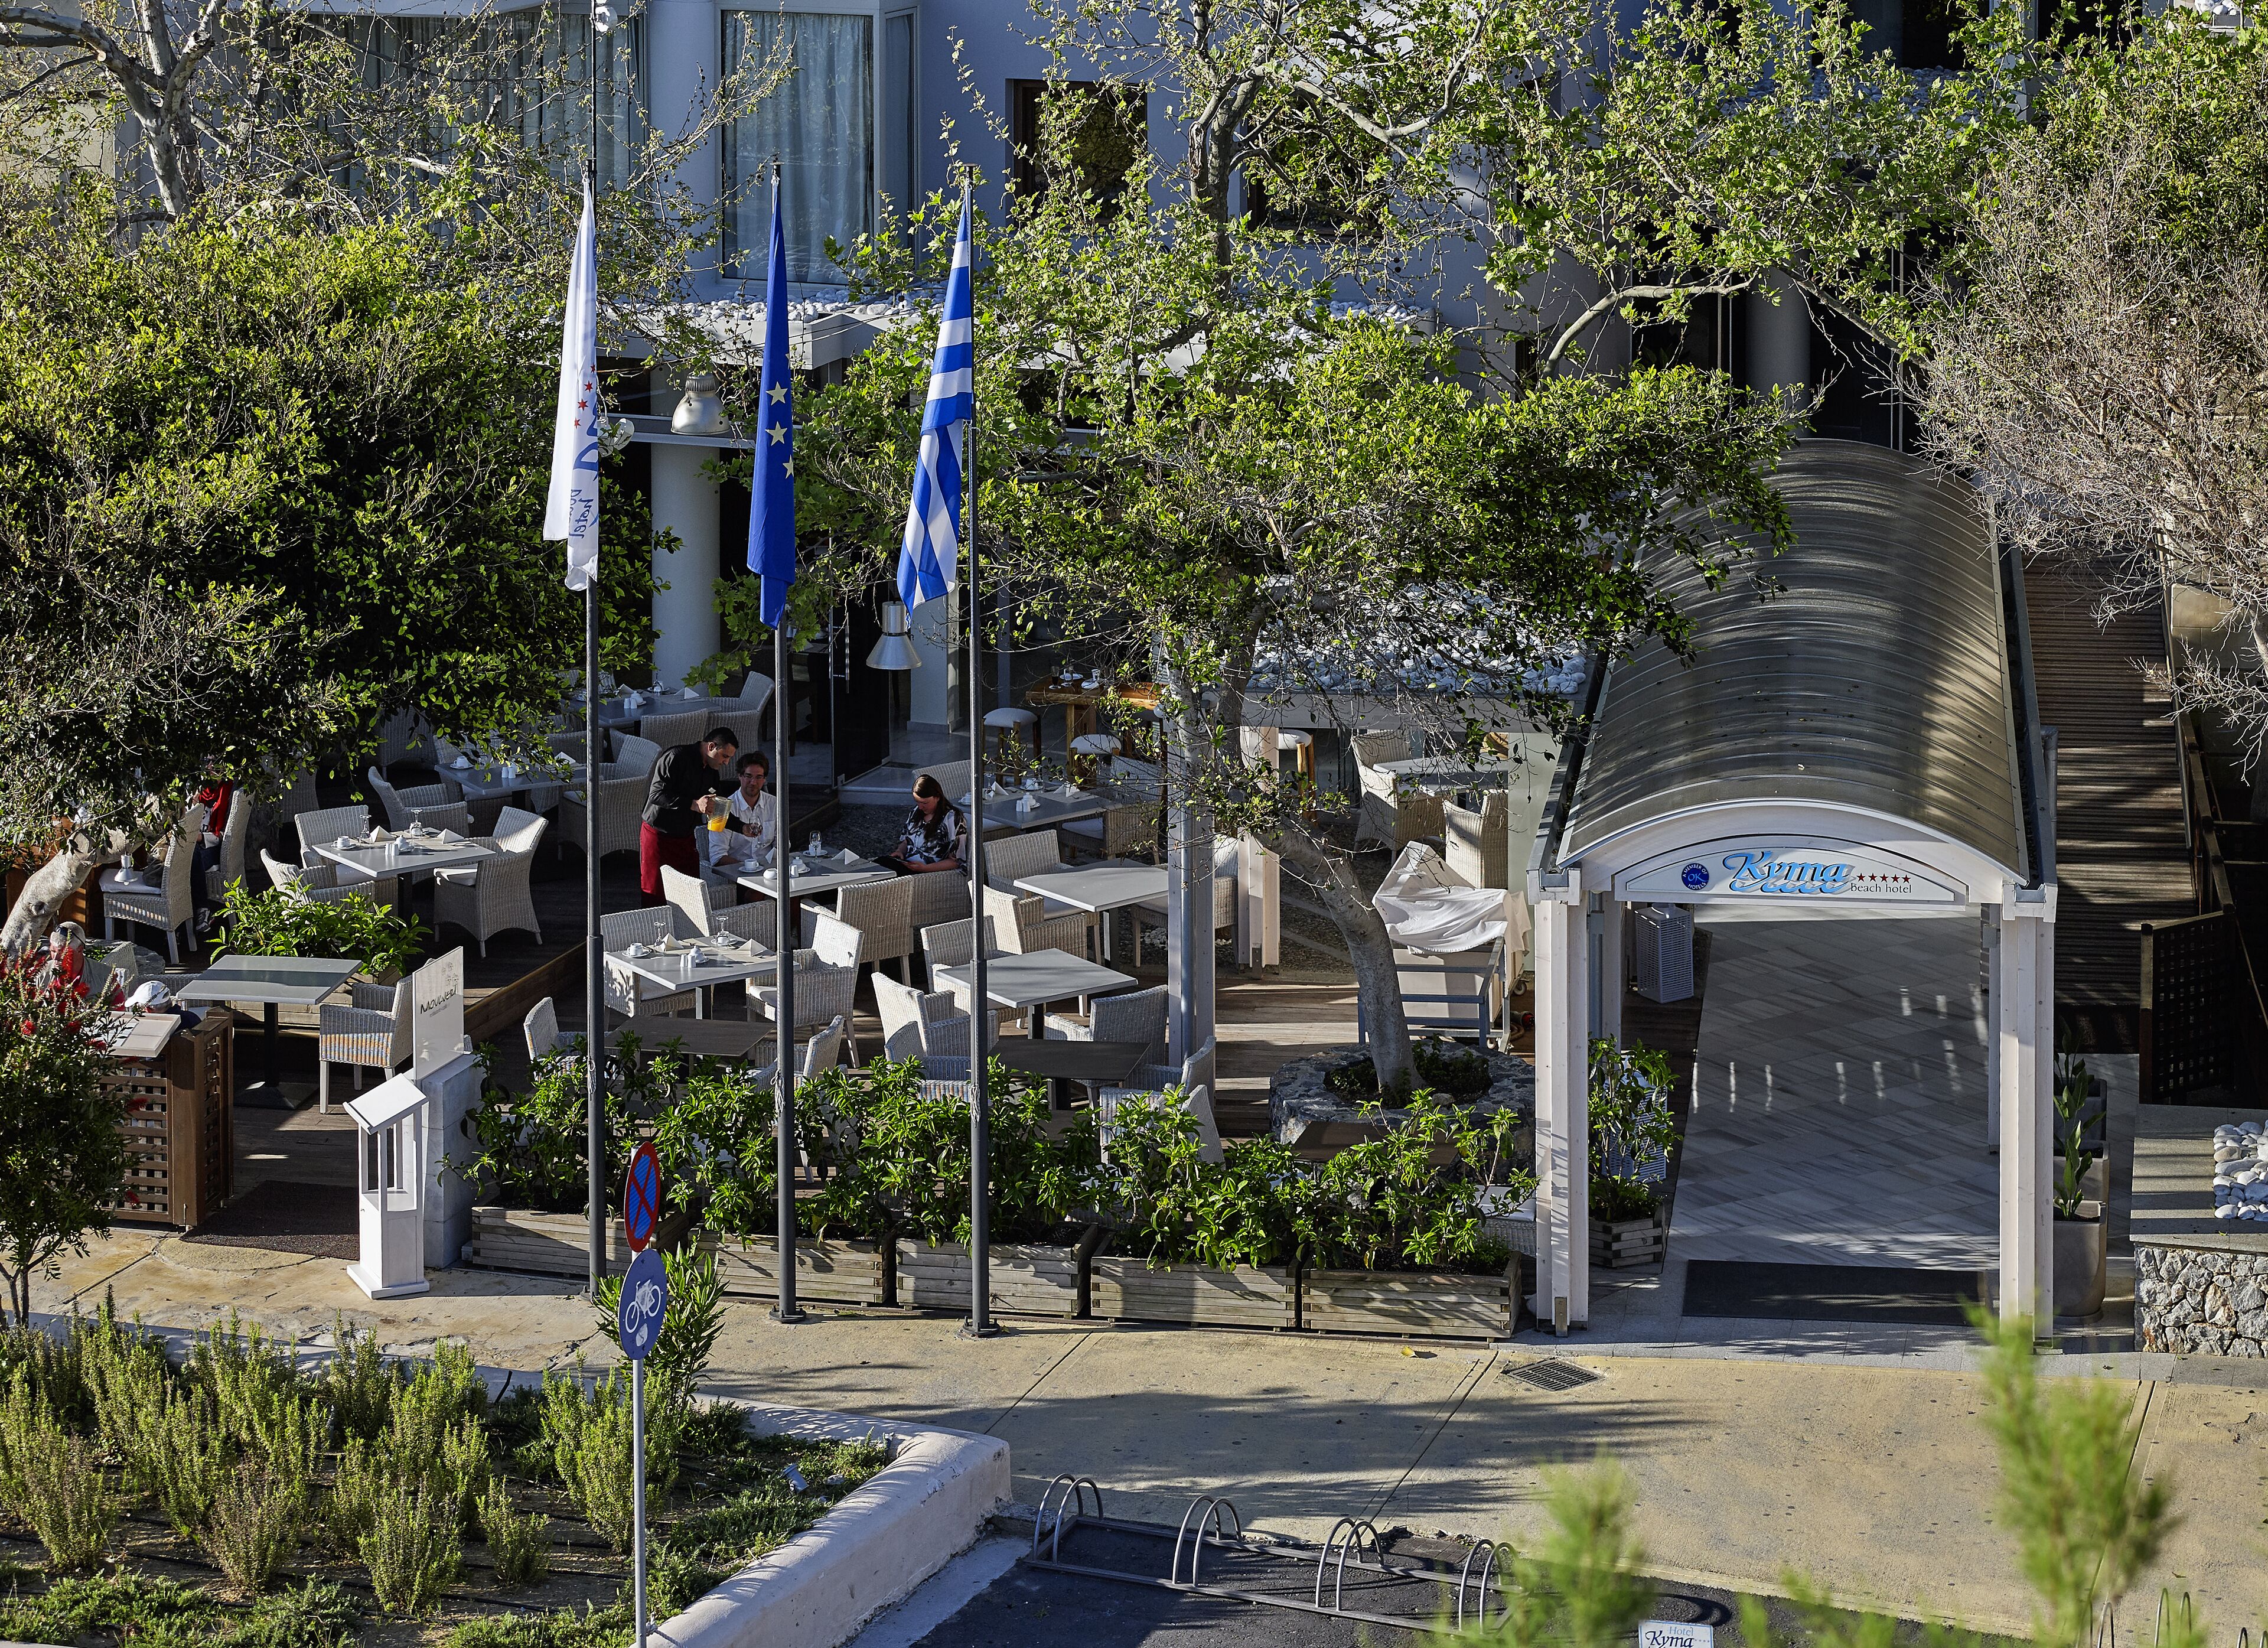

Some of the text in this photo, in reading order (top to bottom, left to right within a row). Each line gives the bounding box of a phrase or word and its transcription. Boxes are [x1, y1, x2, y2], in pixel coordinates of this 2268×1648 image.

[1684, 864, 1702, 873] MEMBER
[1722, 851, 1853, 893] Kyma
[1688, 873, 1707, 882] OK
[1850, 883, 1911, 893] beach hotel
[1669, 1626, 1693, 1636] Hotel
[1645, 1630, 1695, 1648] Kyma
